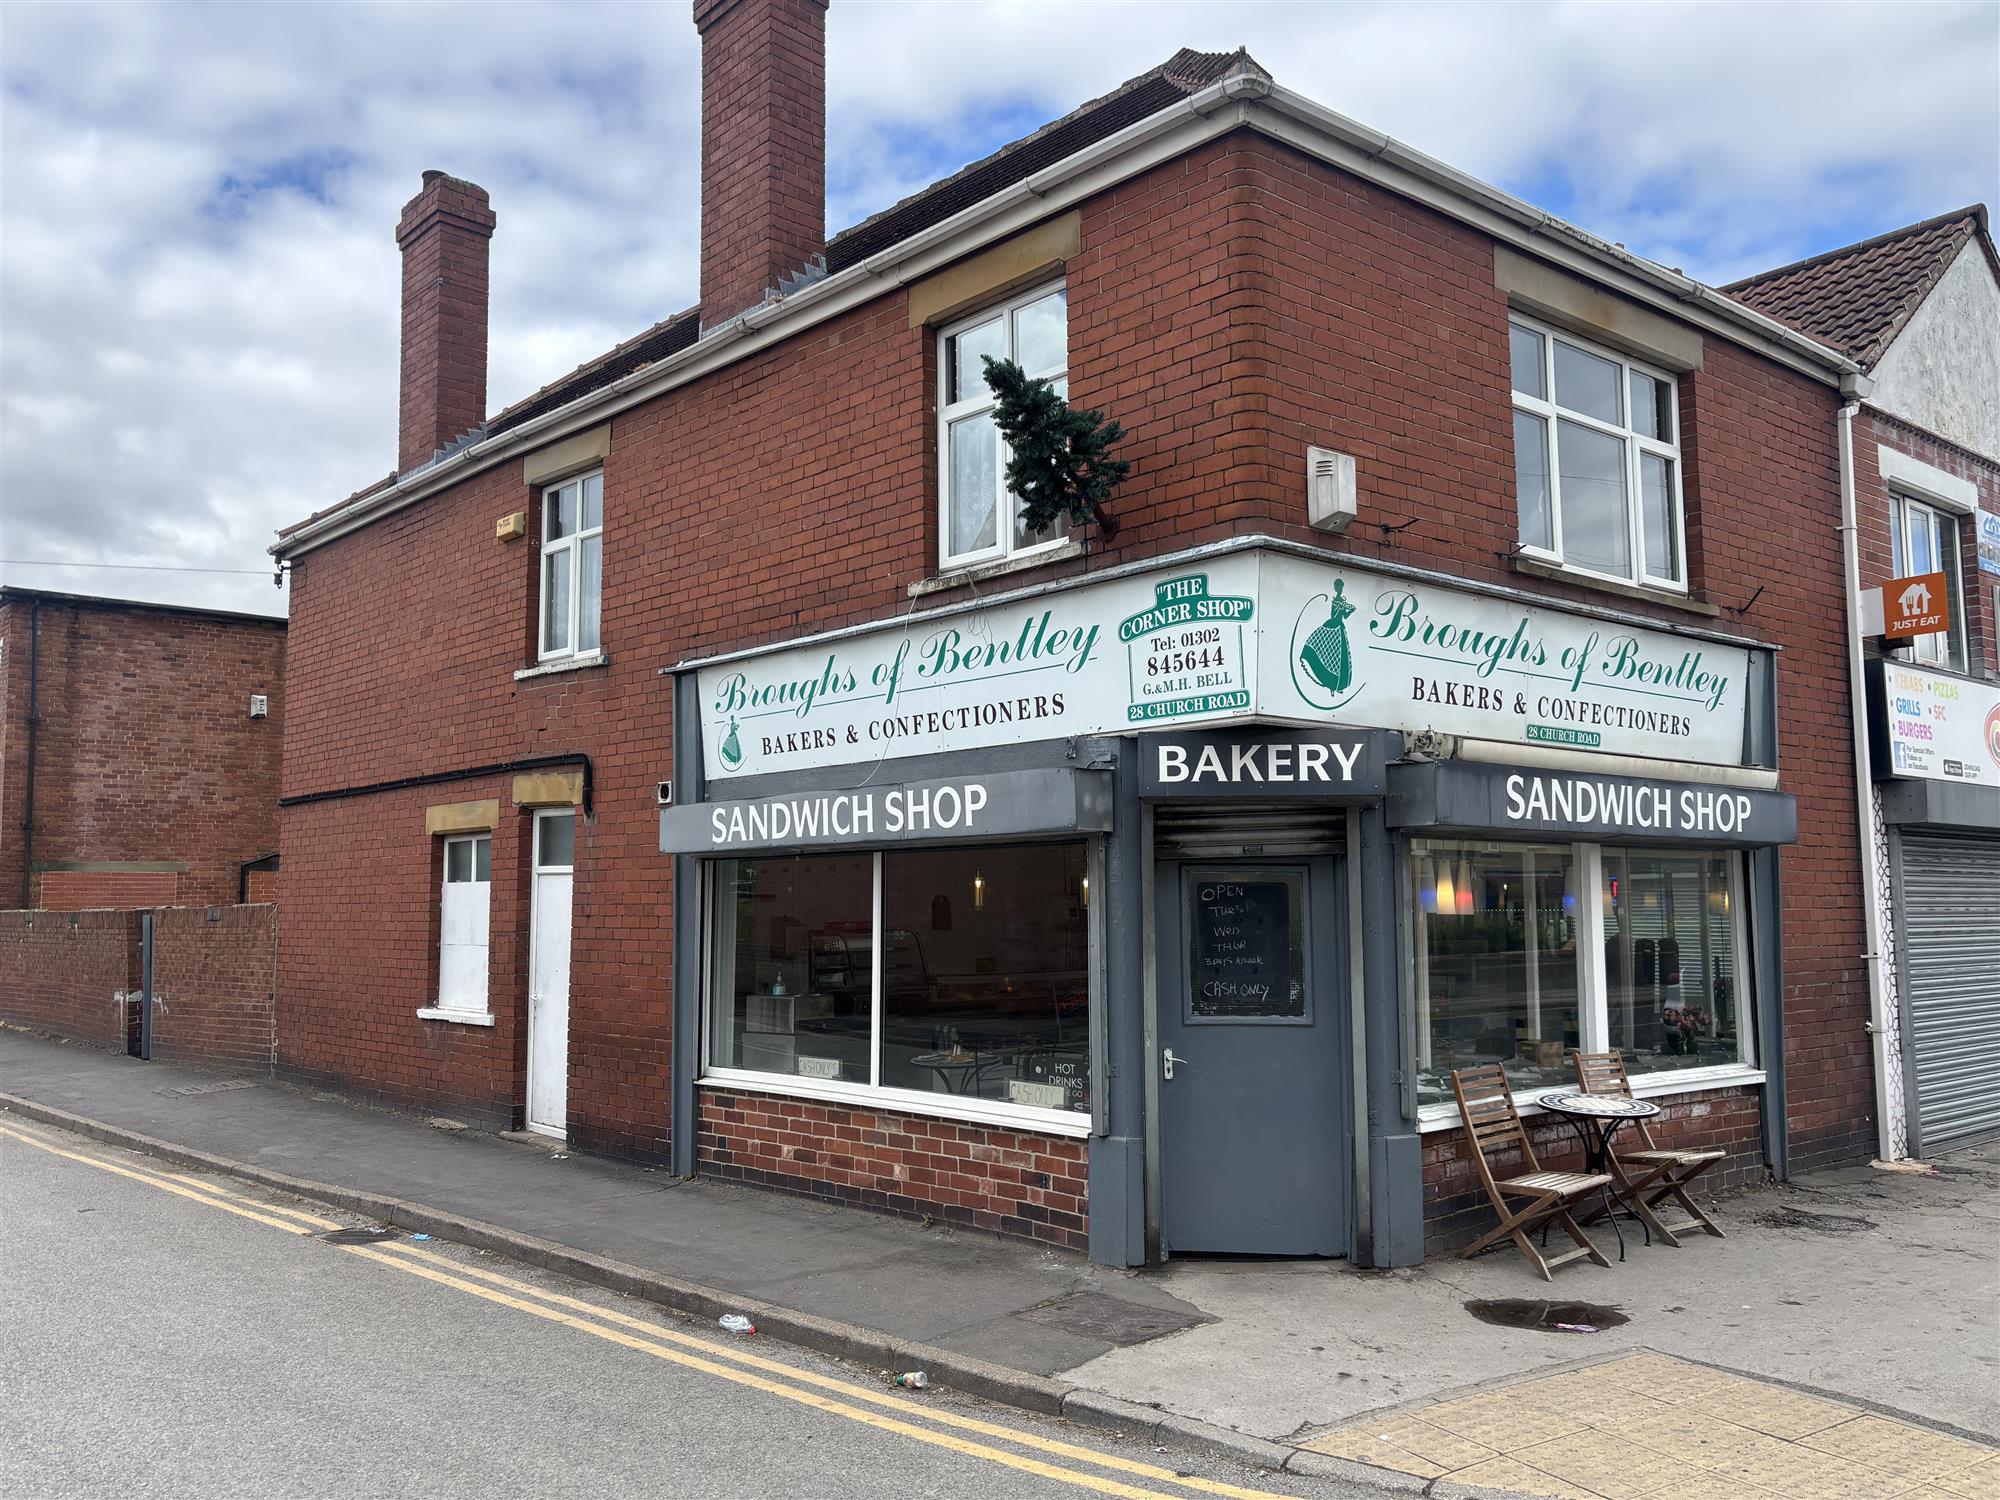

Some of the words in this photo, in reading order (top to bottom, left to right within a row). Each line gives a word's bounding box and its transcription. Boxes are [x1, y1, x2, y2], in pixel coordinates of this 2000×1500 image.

[1157, 577, 1203, 601] "THE
[1120, 604, 1192, 640] CORNER
[1197, 599, 1251, 618] SHOP"
[1891, 619, 1918, 632] JUST
[1919, 615, 1942, 626] EAT
[1151, 636, 1176, 652] Tel:
[1180, 627, 1221, 647] 01302
[1368, 589, 1548, 678] Broughs
[1560, 630, 1599, 693] of
[1602, 635, 1728, 712] Bentley
[714, 655, 858, 719] Broughs
[872, 640, 910, 705] of
[919, 609, 1101, 676] Bentley
[1147, 646, 1225, 677] 845644
[1196, 671, 1233, 688] BELL
[1895, 672, 1924, 693] KEBABS
[1933, 682, 1959, 700] PIZZAS
[1129, 705, 1144, 720] 28
[1147, 698, 1204, 717] CHURCH
[1208, 692, 1247, 708] ROAD
[1412, 676, 1503, 712] BAKERS
[1514, 693, 1527, 715] &
[1538, 696, 1691, 738] CONFECTIONERS
[1896, 697, 1920, 717] GRILLS
[1934, 705, 1946, 721] SFC
[761, 727, 836, 756] BAKERS
[845, 725, 859, 744] &
[868, 692, 1066, 740] CONFECTIONERS
[1528, 726, 1538, 739] 28
[1541, 727, 1575, 743] CHURCH
[1577, 730, 1599, 745] ROAD
[1898, 720, 1933, 740] BURGERS
[1157, 743, 1363, 782] BAKERY
[710, 794, 873, 843] SANDWICH
[884, 784, 987, 832] SHOP
[1506, 775, 1672, 828] SANDWICH
[1680, 791, 1752, 833] SHOP
[1201, 885, 1244, 901] OPEN
[1203, 981, 1237, 998] CASH
[1240, 984, 1270, 1003] ONLY
[1054, 1062, 1075, 1075] HOT
[1048, 1075, 1083, 1089] DRINKS
